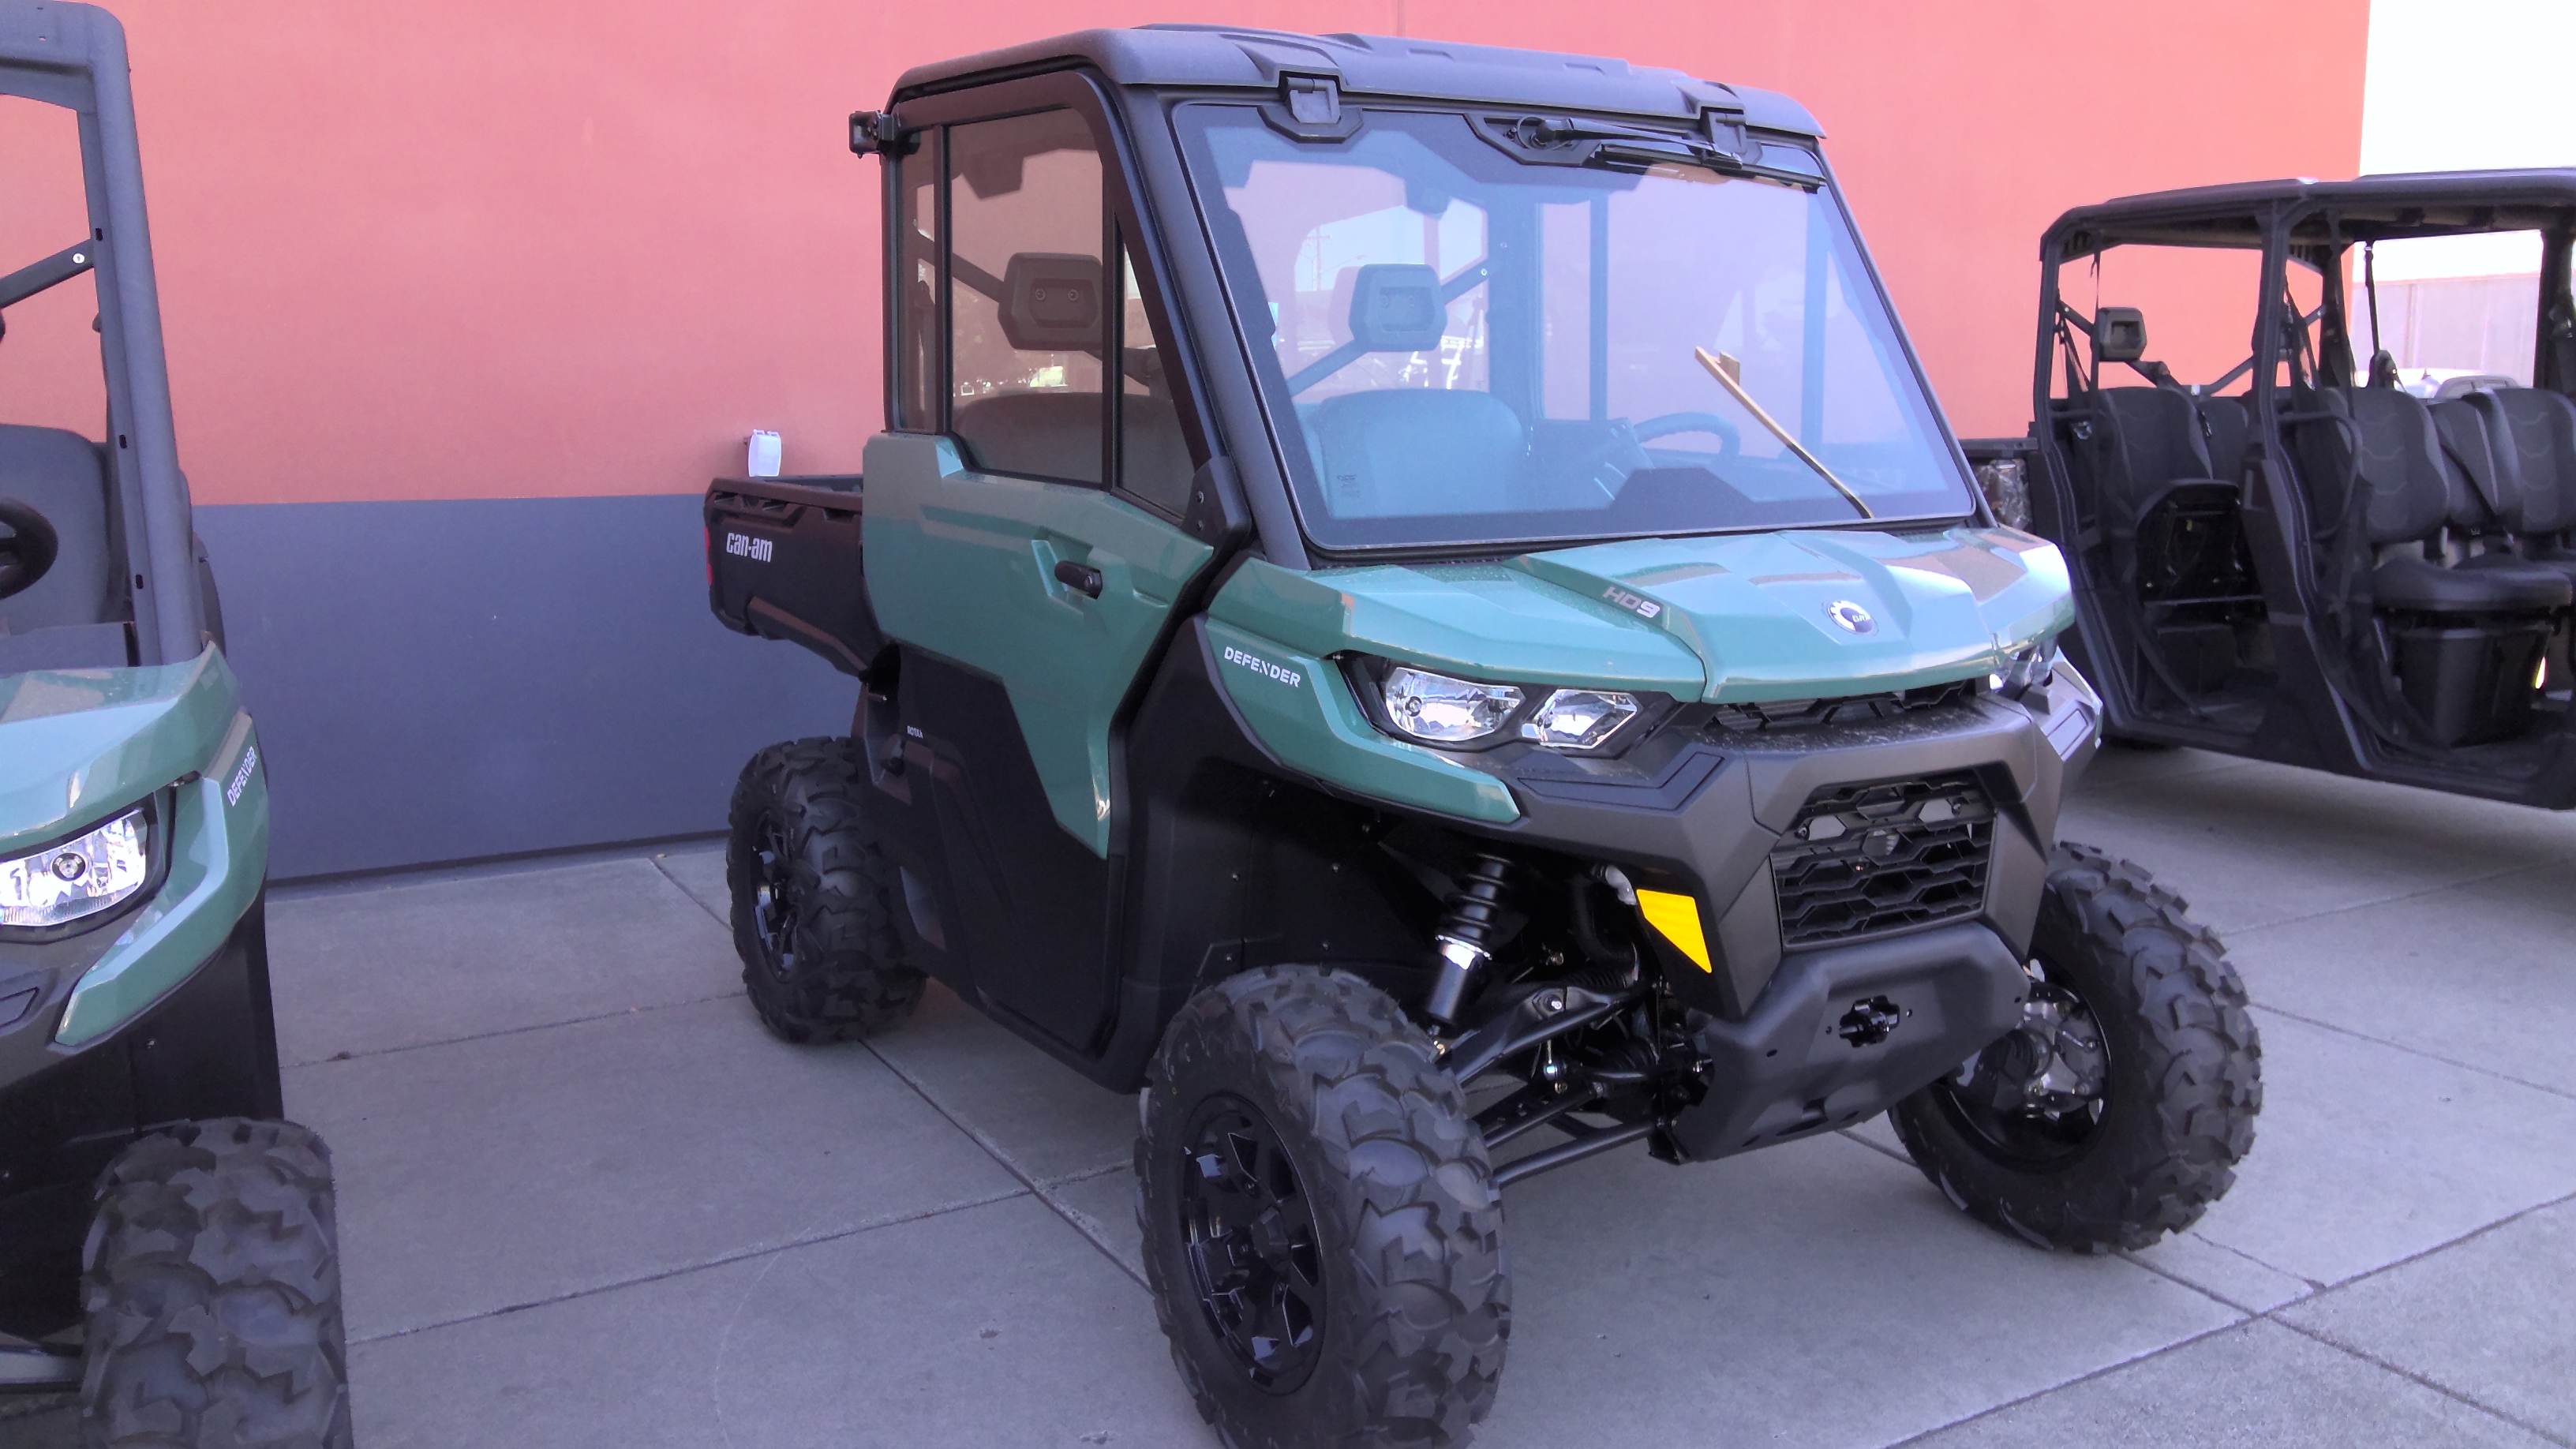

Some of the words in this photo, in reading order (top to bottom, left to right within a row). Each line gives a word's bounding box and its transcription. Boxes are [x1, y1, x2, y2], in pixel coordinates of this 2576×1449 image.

[726, 532, 773, 563] can-am
[1602, 586, 1661, 618] HD9
[1224, 646, 1301, 687] DEFENDER
[227, 746, 257, 807] DEFENDER
